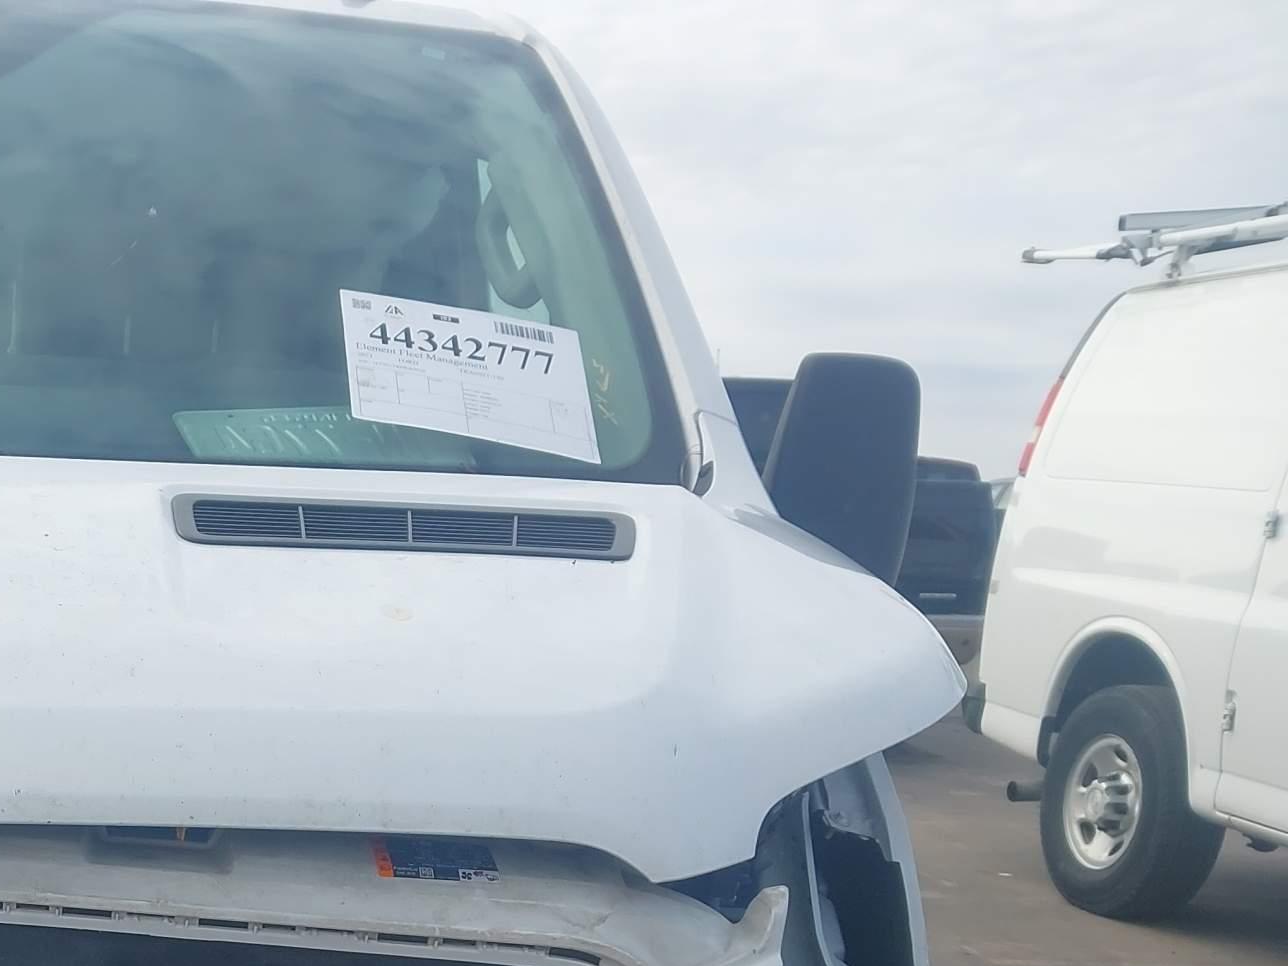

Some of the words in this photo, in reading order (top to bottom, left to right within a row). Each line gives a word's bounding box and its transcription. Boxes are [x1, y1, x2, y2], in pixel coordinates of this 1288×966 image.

[356, 342, 396, 355] Element
[399, 349, 423, 360] Fleet
[426, 353, 488, 371] Management
[369, 322, 554, 375] 44342777
